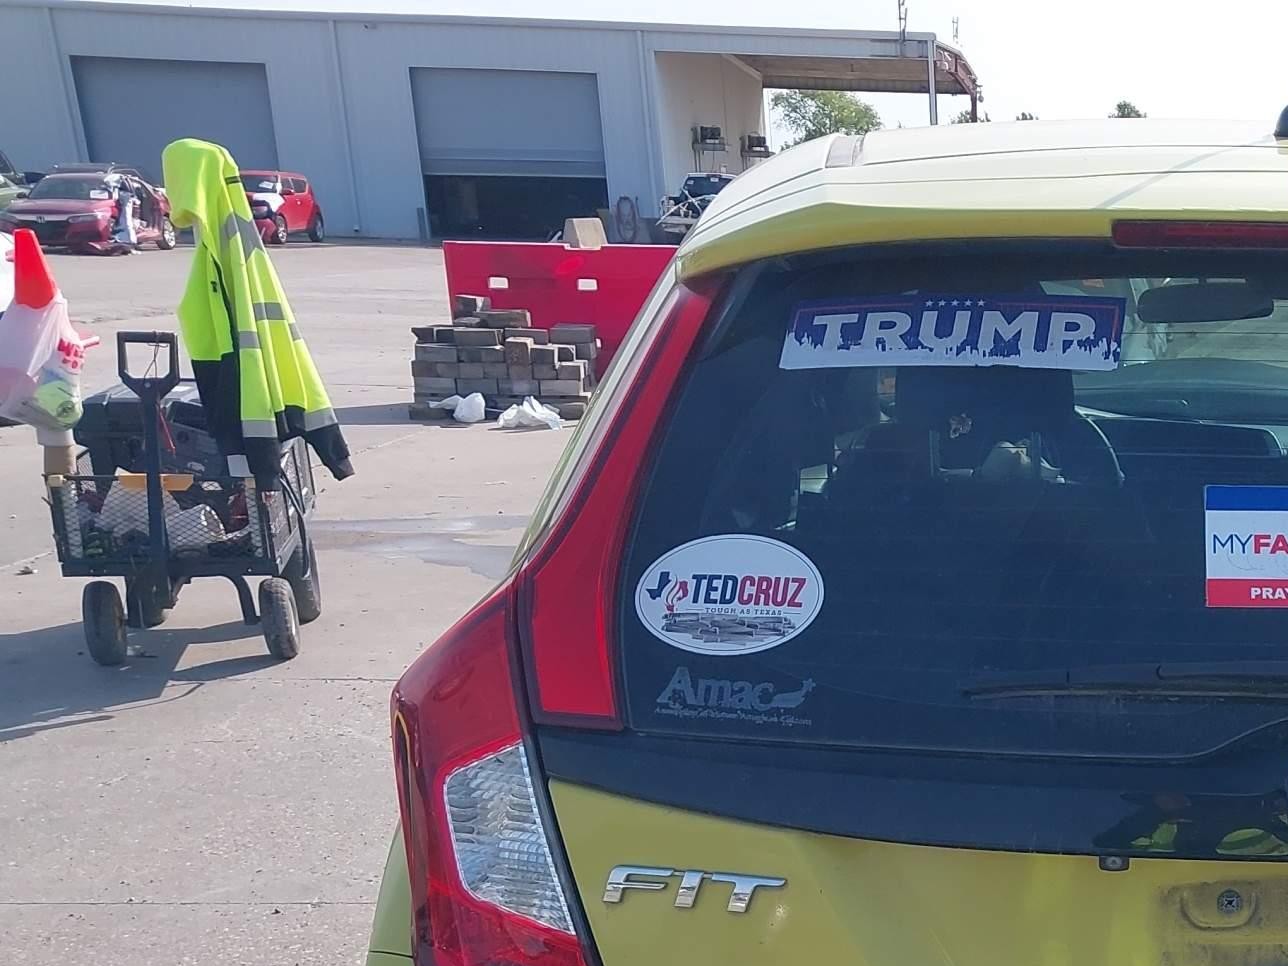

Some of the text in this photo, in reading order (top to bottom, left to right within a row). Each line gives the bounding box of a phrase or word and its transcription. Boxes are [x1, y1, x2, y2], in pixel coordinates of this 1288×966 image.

[812, 310, 1097, 352] TRUMP
[704, 607, 737, 615] TOUGH
[754, 608, 782, 616] TEXAS
[602, 864, 787, 913] FIT
